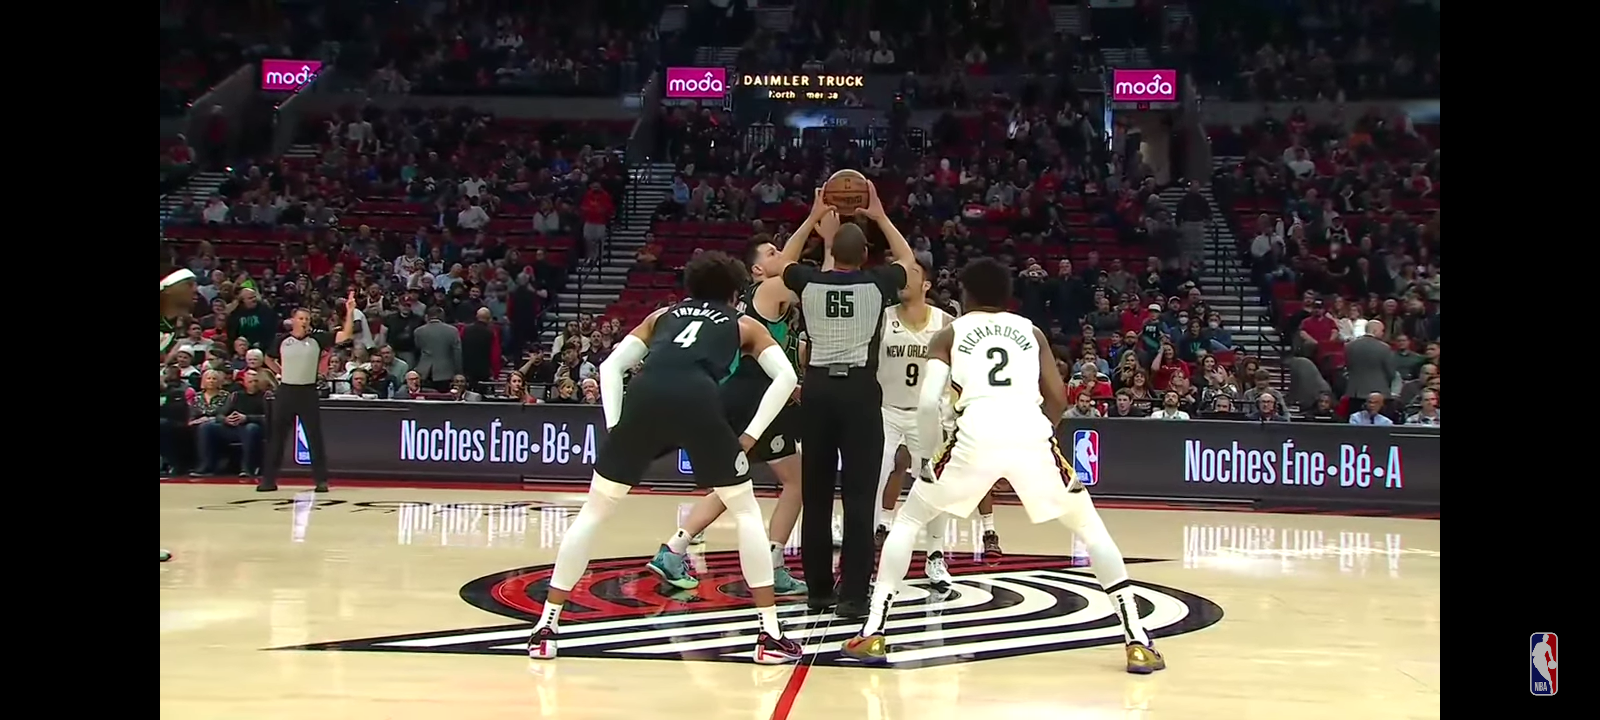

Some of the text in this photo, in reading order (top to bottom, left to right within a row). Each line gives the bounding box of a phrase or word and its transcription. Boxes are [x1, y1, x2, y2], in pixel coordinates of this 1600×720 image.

[669, 71, 723, 92] moda
[743, 75, 864, 87] DAIMLER TRUCK
[1116, 74, 1172, 95] moda
[826, 291, 854, 318] 65
[673, 321, 704, 348] 4
[958, 325, 1033, 355] RICHARDSON
[886, 345, 906, 358] NEW
[905, 363, 919, 387] 9
[986, 347, 1012, 387] 2
[400, 420, 486, 462] Noches
[1184, 440, 1277, 485] Noches
